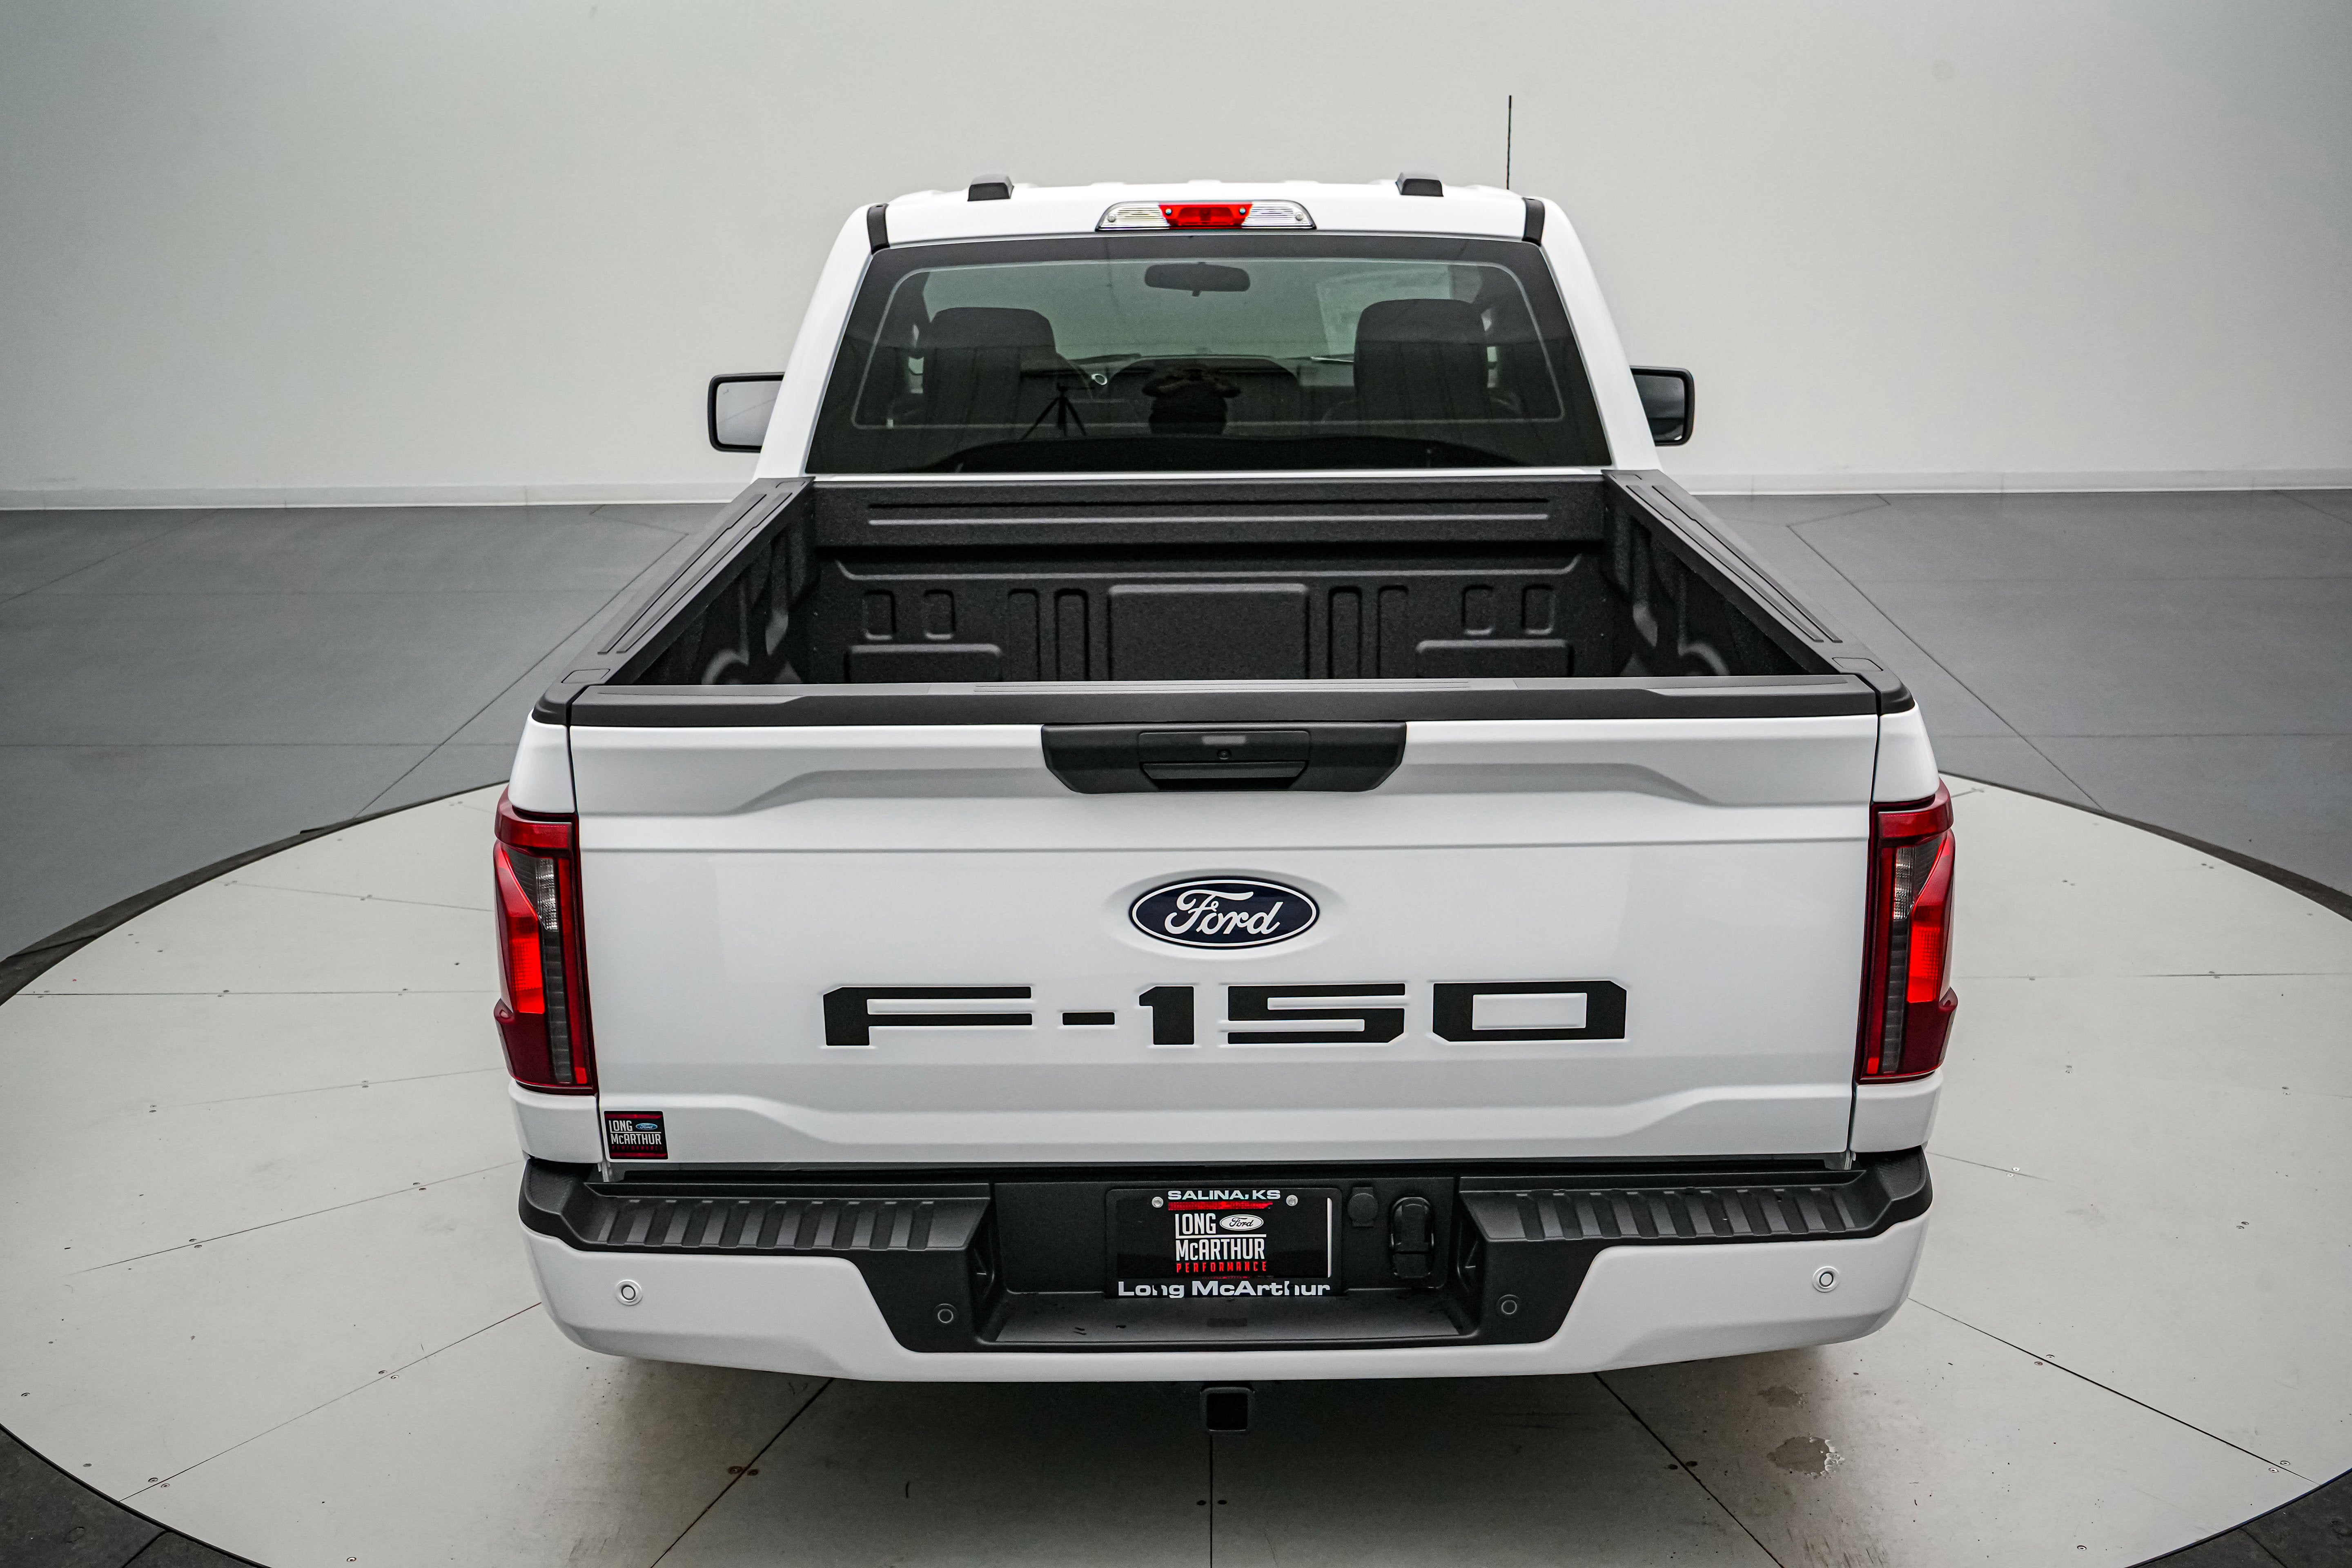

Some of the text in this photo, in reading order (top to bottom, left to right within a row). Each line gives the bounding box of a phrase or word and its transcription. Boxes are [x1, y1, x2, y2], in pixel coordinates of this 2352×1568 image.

[1165, 889, 1283, 935] Ford
[823, 980, 1627, 1047] F-150
[608, 1120, 633, 1132] LONG
[610, 1133, 662, 1145] McARTHUR
[1175, 1213, 1216, 1238] LONG
[1229, 1217, 1254, 1227] Ford
[1176, 1239, 1265, 1261] McARTHUR
[1176, 1261, 1266, 1273] PERFORMANCE
[1118, 1281, 1330, 1298] Long McArthur
